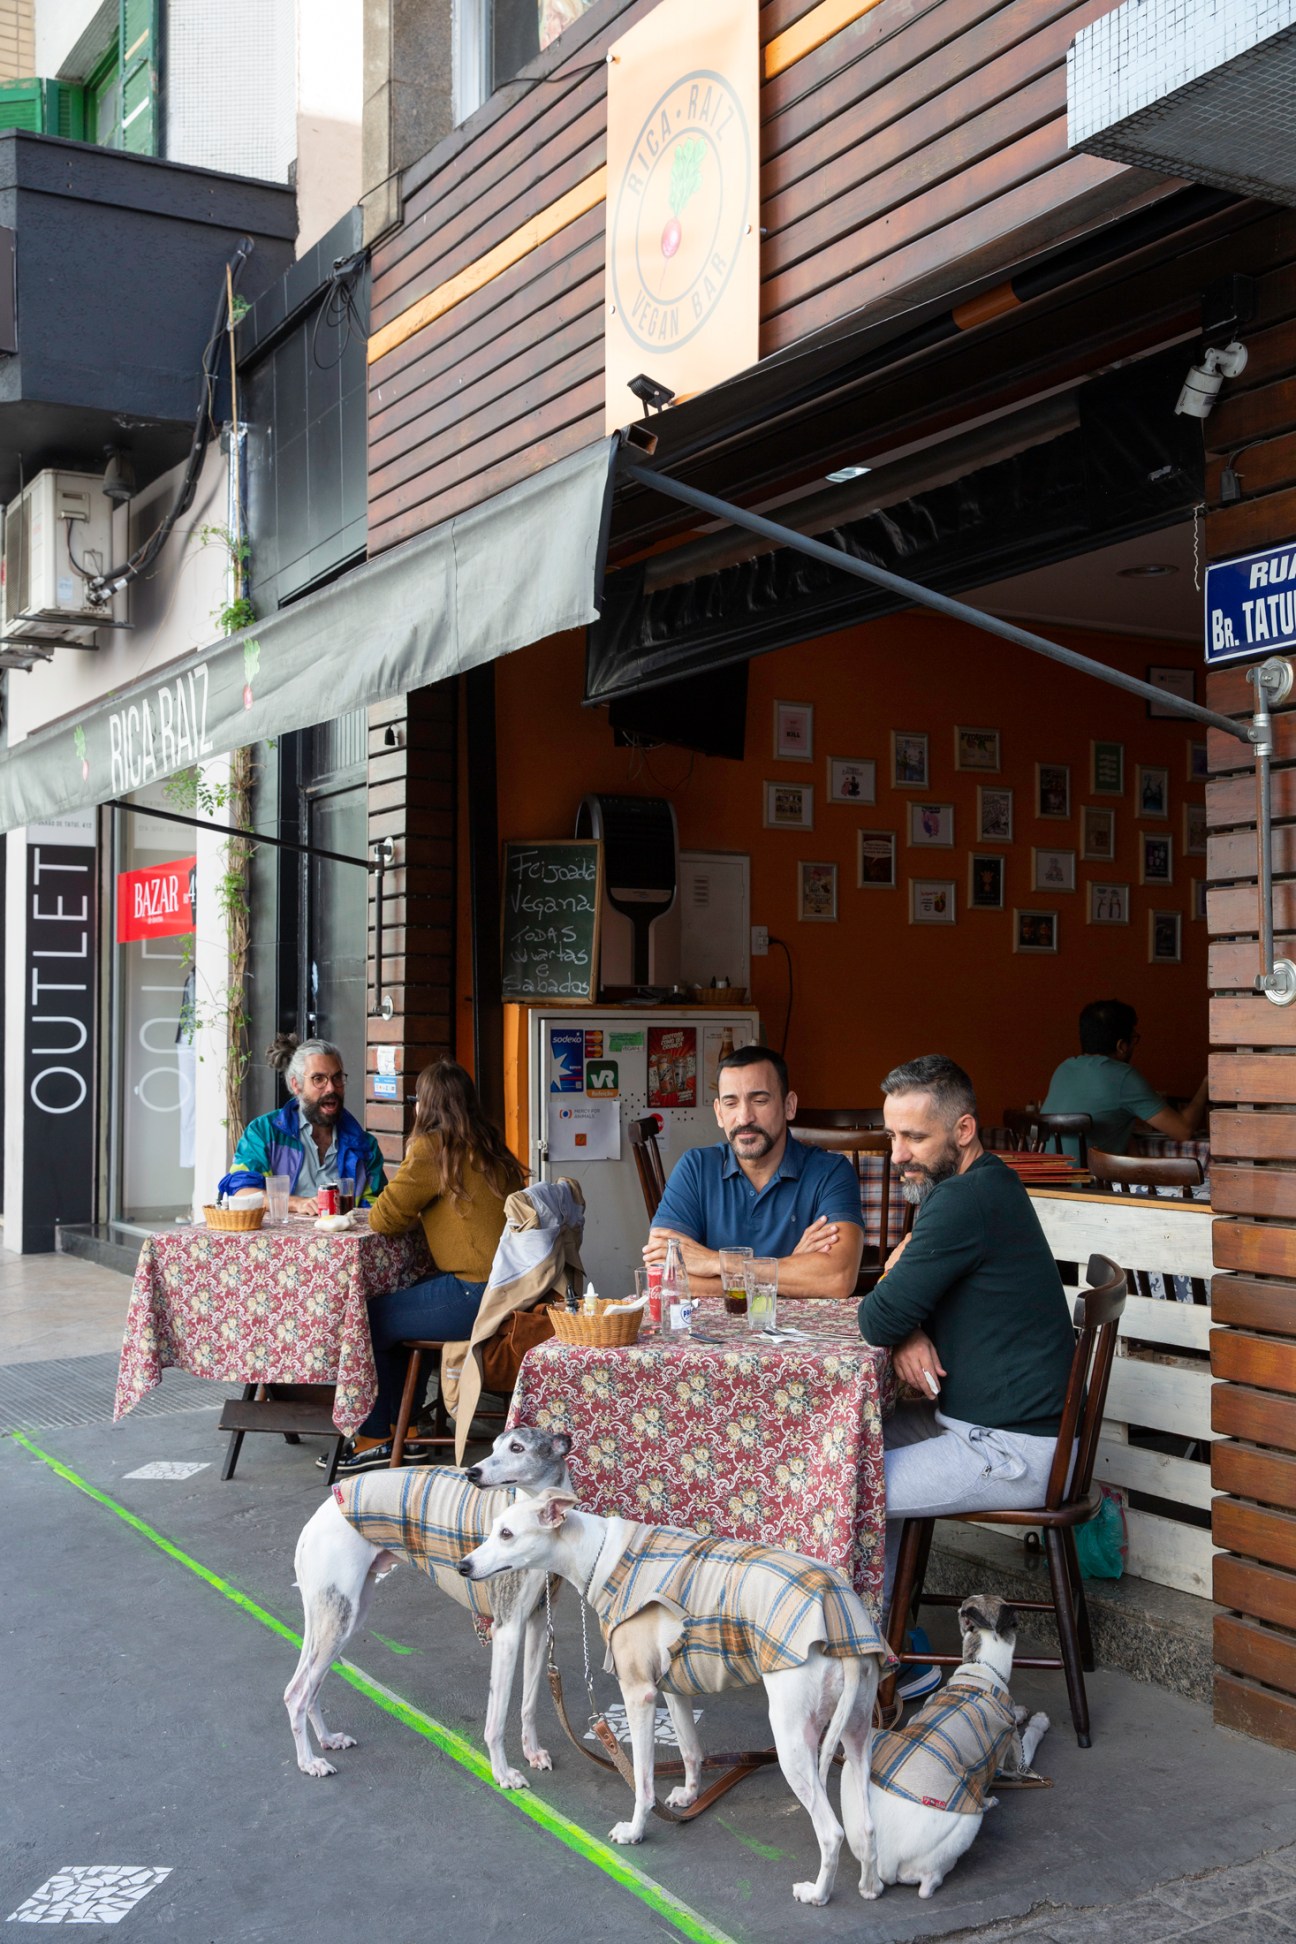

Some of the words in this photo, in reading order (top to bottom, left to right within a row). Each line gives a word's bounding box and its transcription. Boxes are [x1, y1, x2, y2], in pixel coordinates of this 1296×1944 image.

[627, 109, 672, 196] RICA
[687, 84, 736, 143] RAIZ
[631, 289, 680, 341] VEGAN
[691, 252, 728, 320] BAR
[1242, 590, 1296, 643] TATU
[109, 698, 157, 794] RICA
[158, 662, 213, 773] RAIZ
[511, 850, 596, 883] Feijoada
[134, 875, 179, 918] BAZAR
[30, 847, 88, 1114] OUTLET
[536, 964, 549, 976] e
[552, 1034, 582, 1044] sodexo
